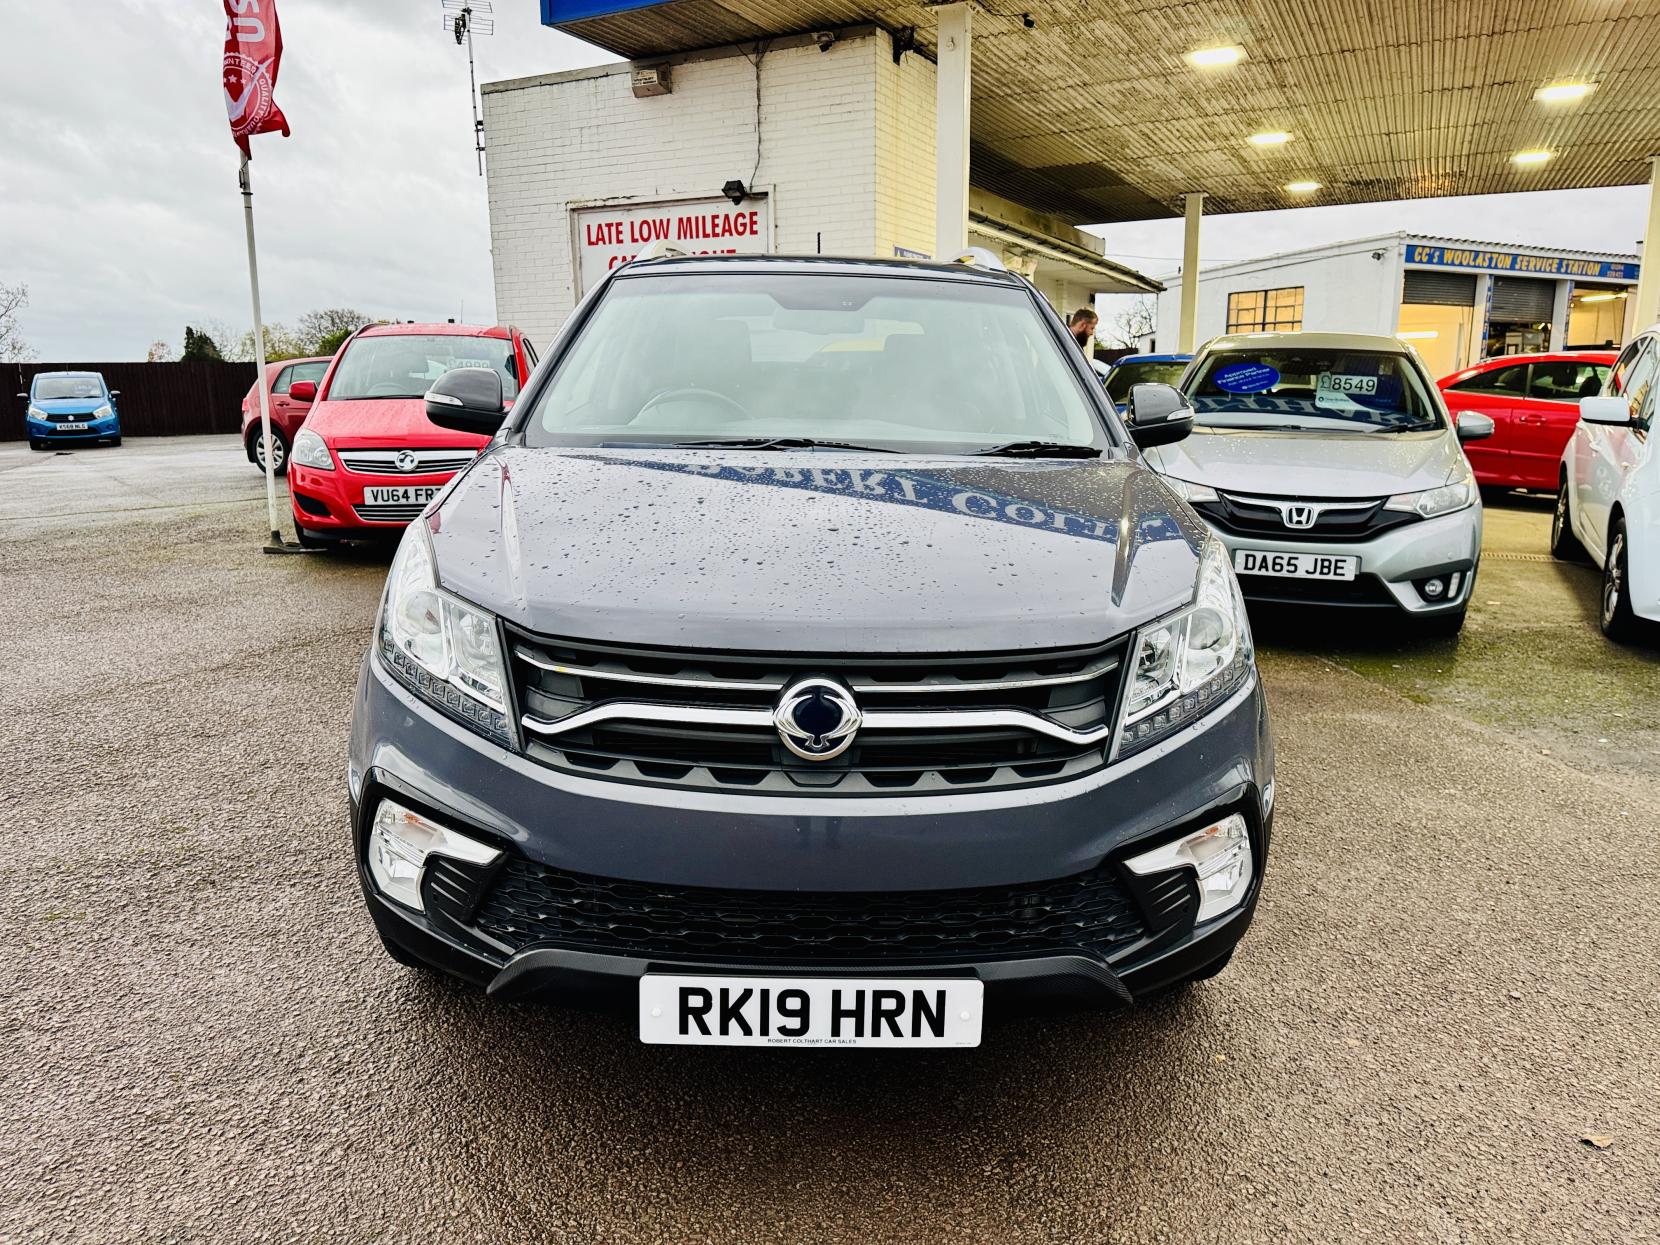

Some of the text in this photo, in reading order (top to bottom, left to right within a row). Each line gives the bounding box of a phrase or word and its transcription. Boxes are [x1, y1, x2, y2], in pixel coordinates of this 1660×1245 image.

[586, 211, 759, 246] LATE LOW MILEAGE
[1443, 249, 1512, 269] WOOLASTON
[1515, 255, 1560, 273] SERVICE
[1560, 259, 1601, 276] STATION
[371, 488, 410, 503] VU64
[1243, 553, 1347, 577] DA65 JBE
[678, 986, 947, 1038] RK19 HRN
